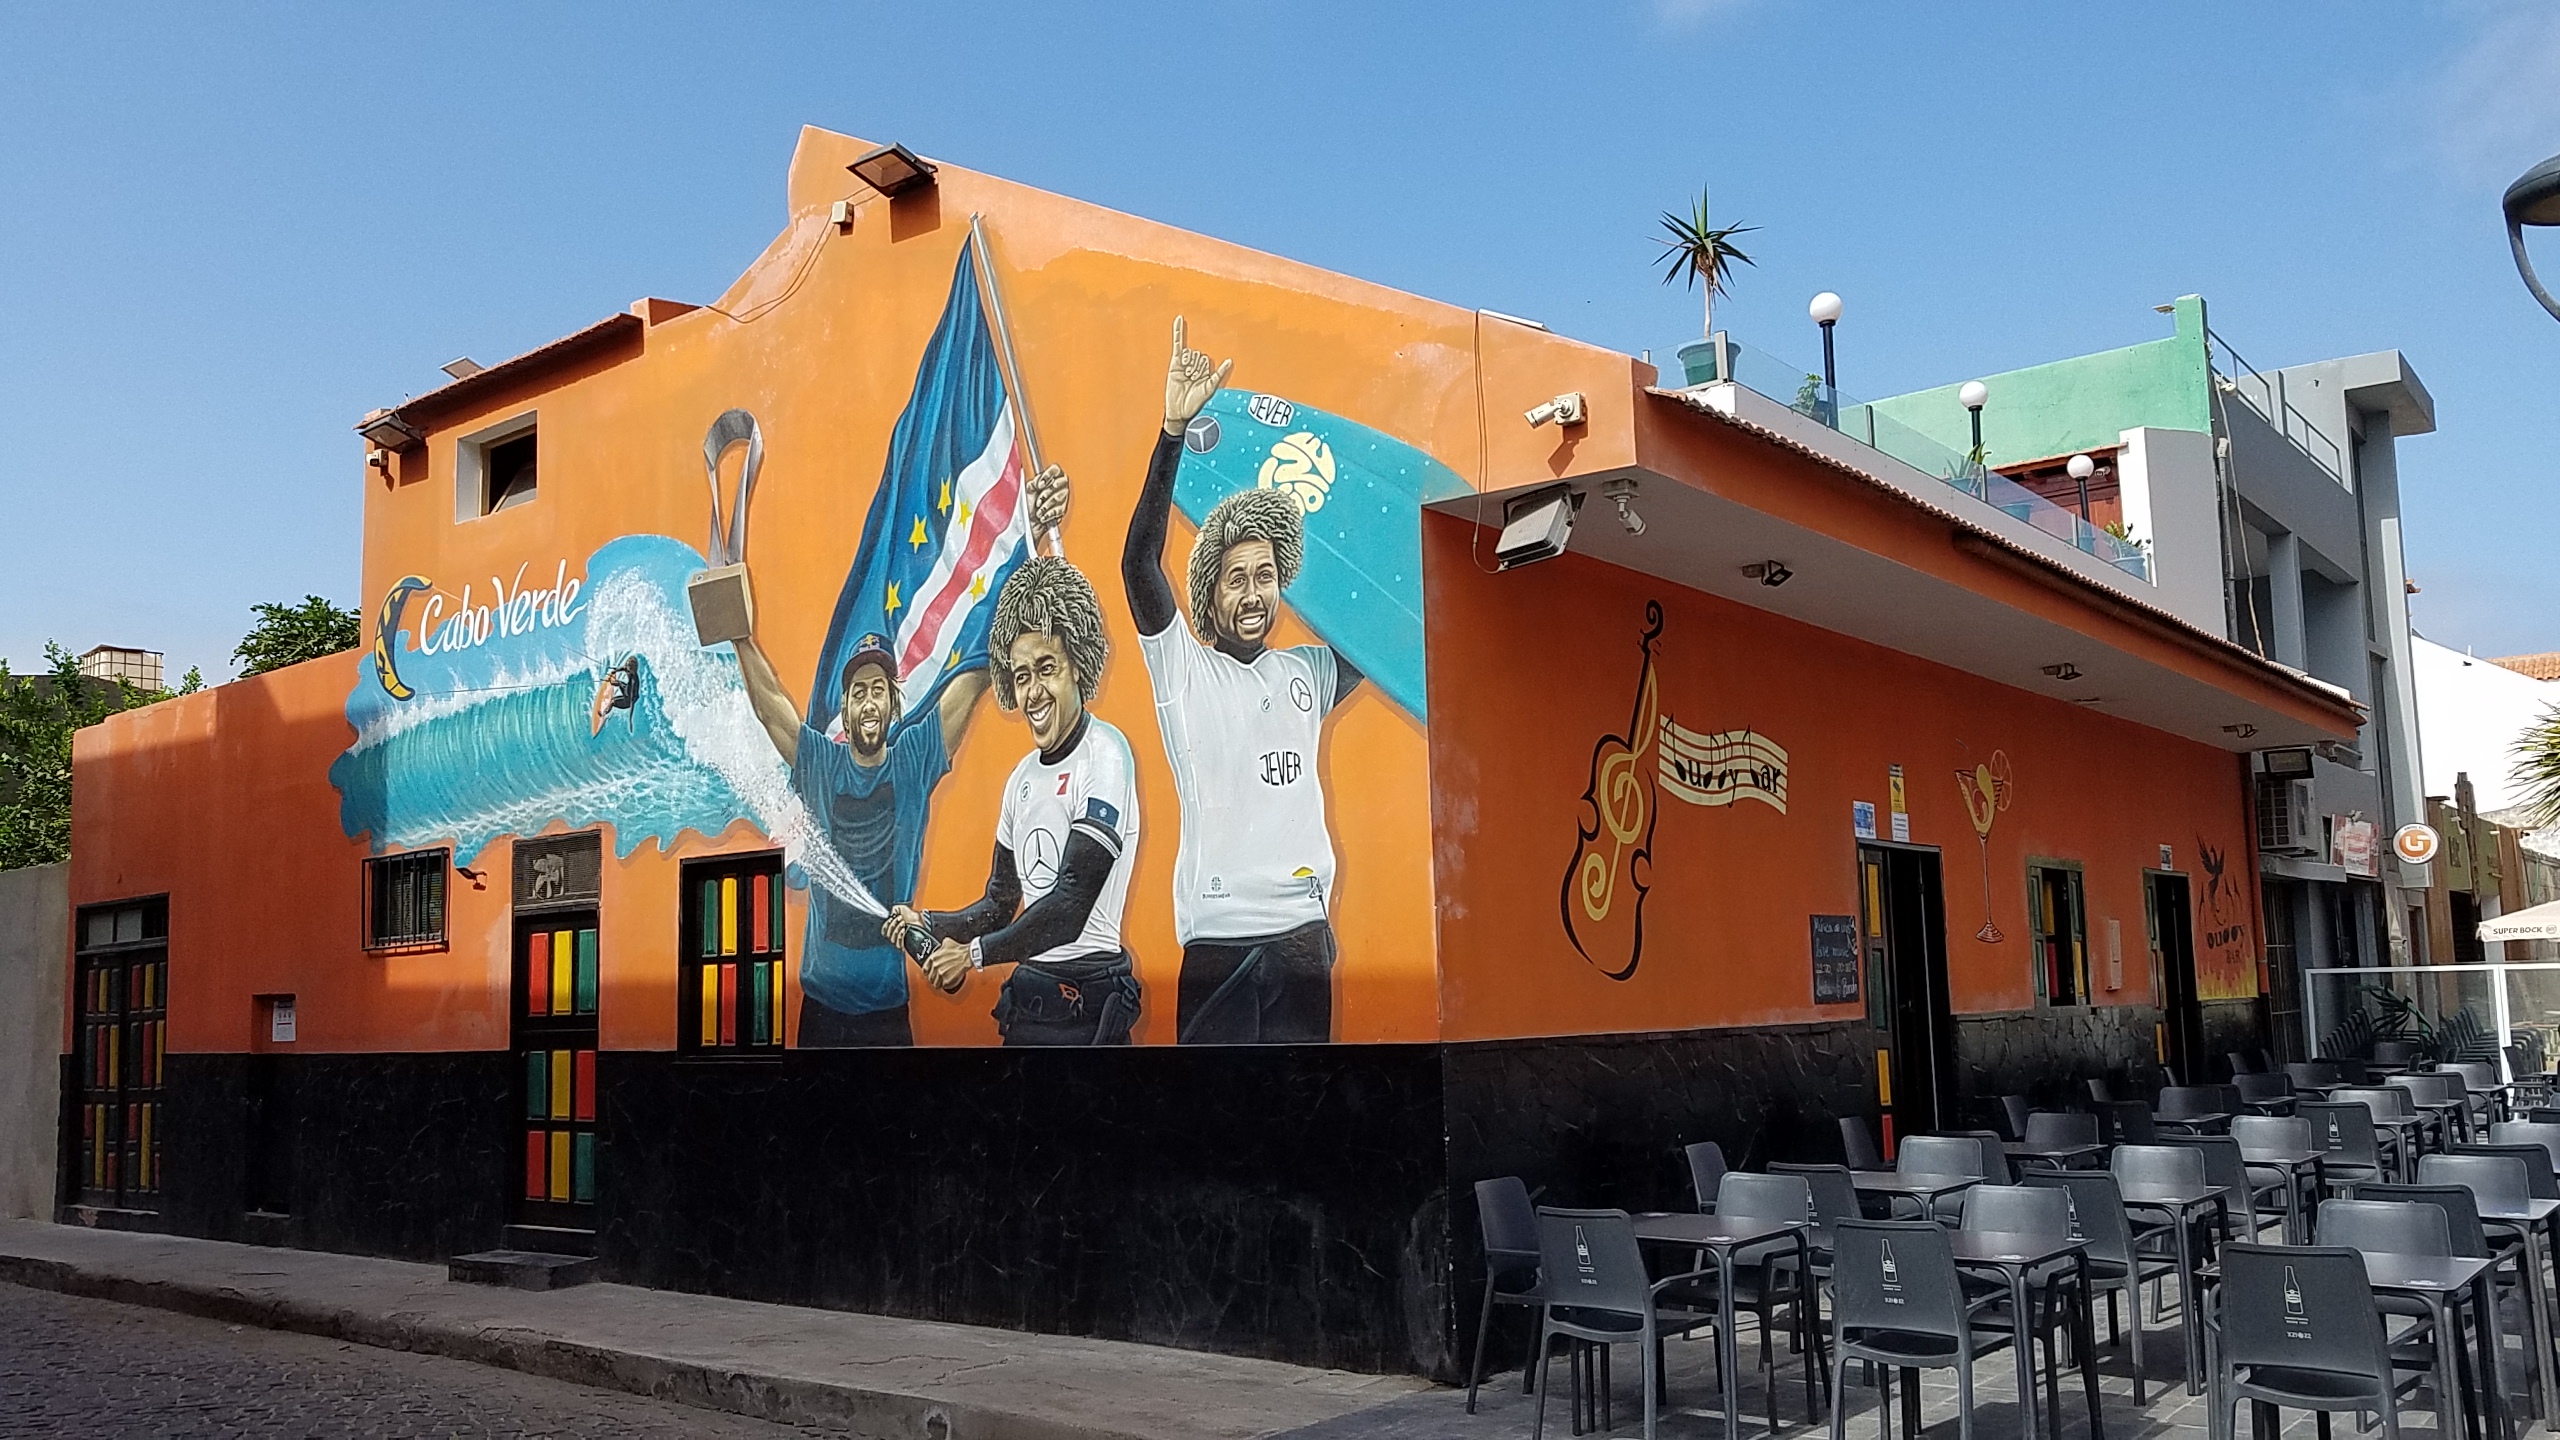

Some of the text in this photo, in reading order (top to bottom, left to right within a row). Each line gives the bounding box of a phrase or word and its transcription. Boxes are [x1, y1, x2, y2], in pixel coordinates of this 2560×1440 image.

[1249, 396, 1292, 425] JEVER
[420, 558, 588, 656] Cabo Verde
[1259, 751, 1302, 786] JEVER
[2493, 927, 2519, 935] SUPER
[2520, 926, 2543, 934] BOCK
